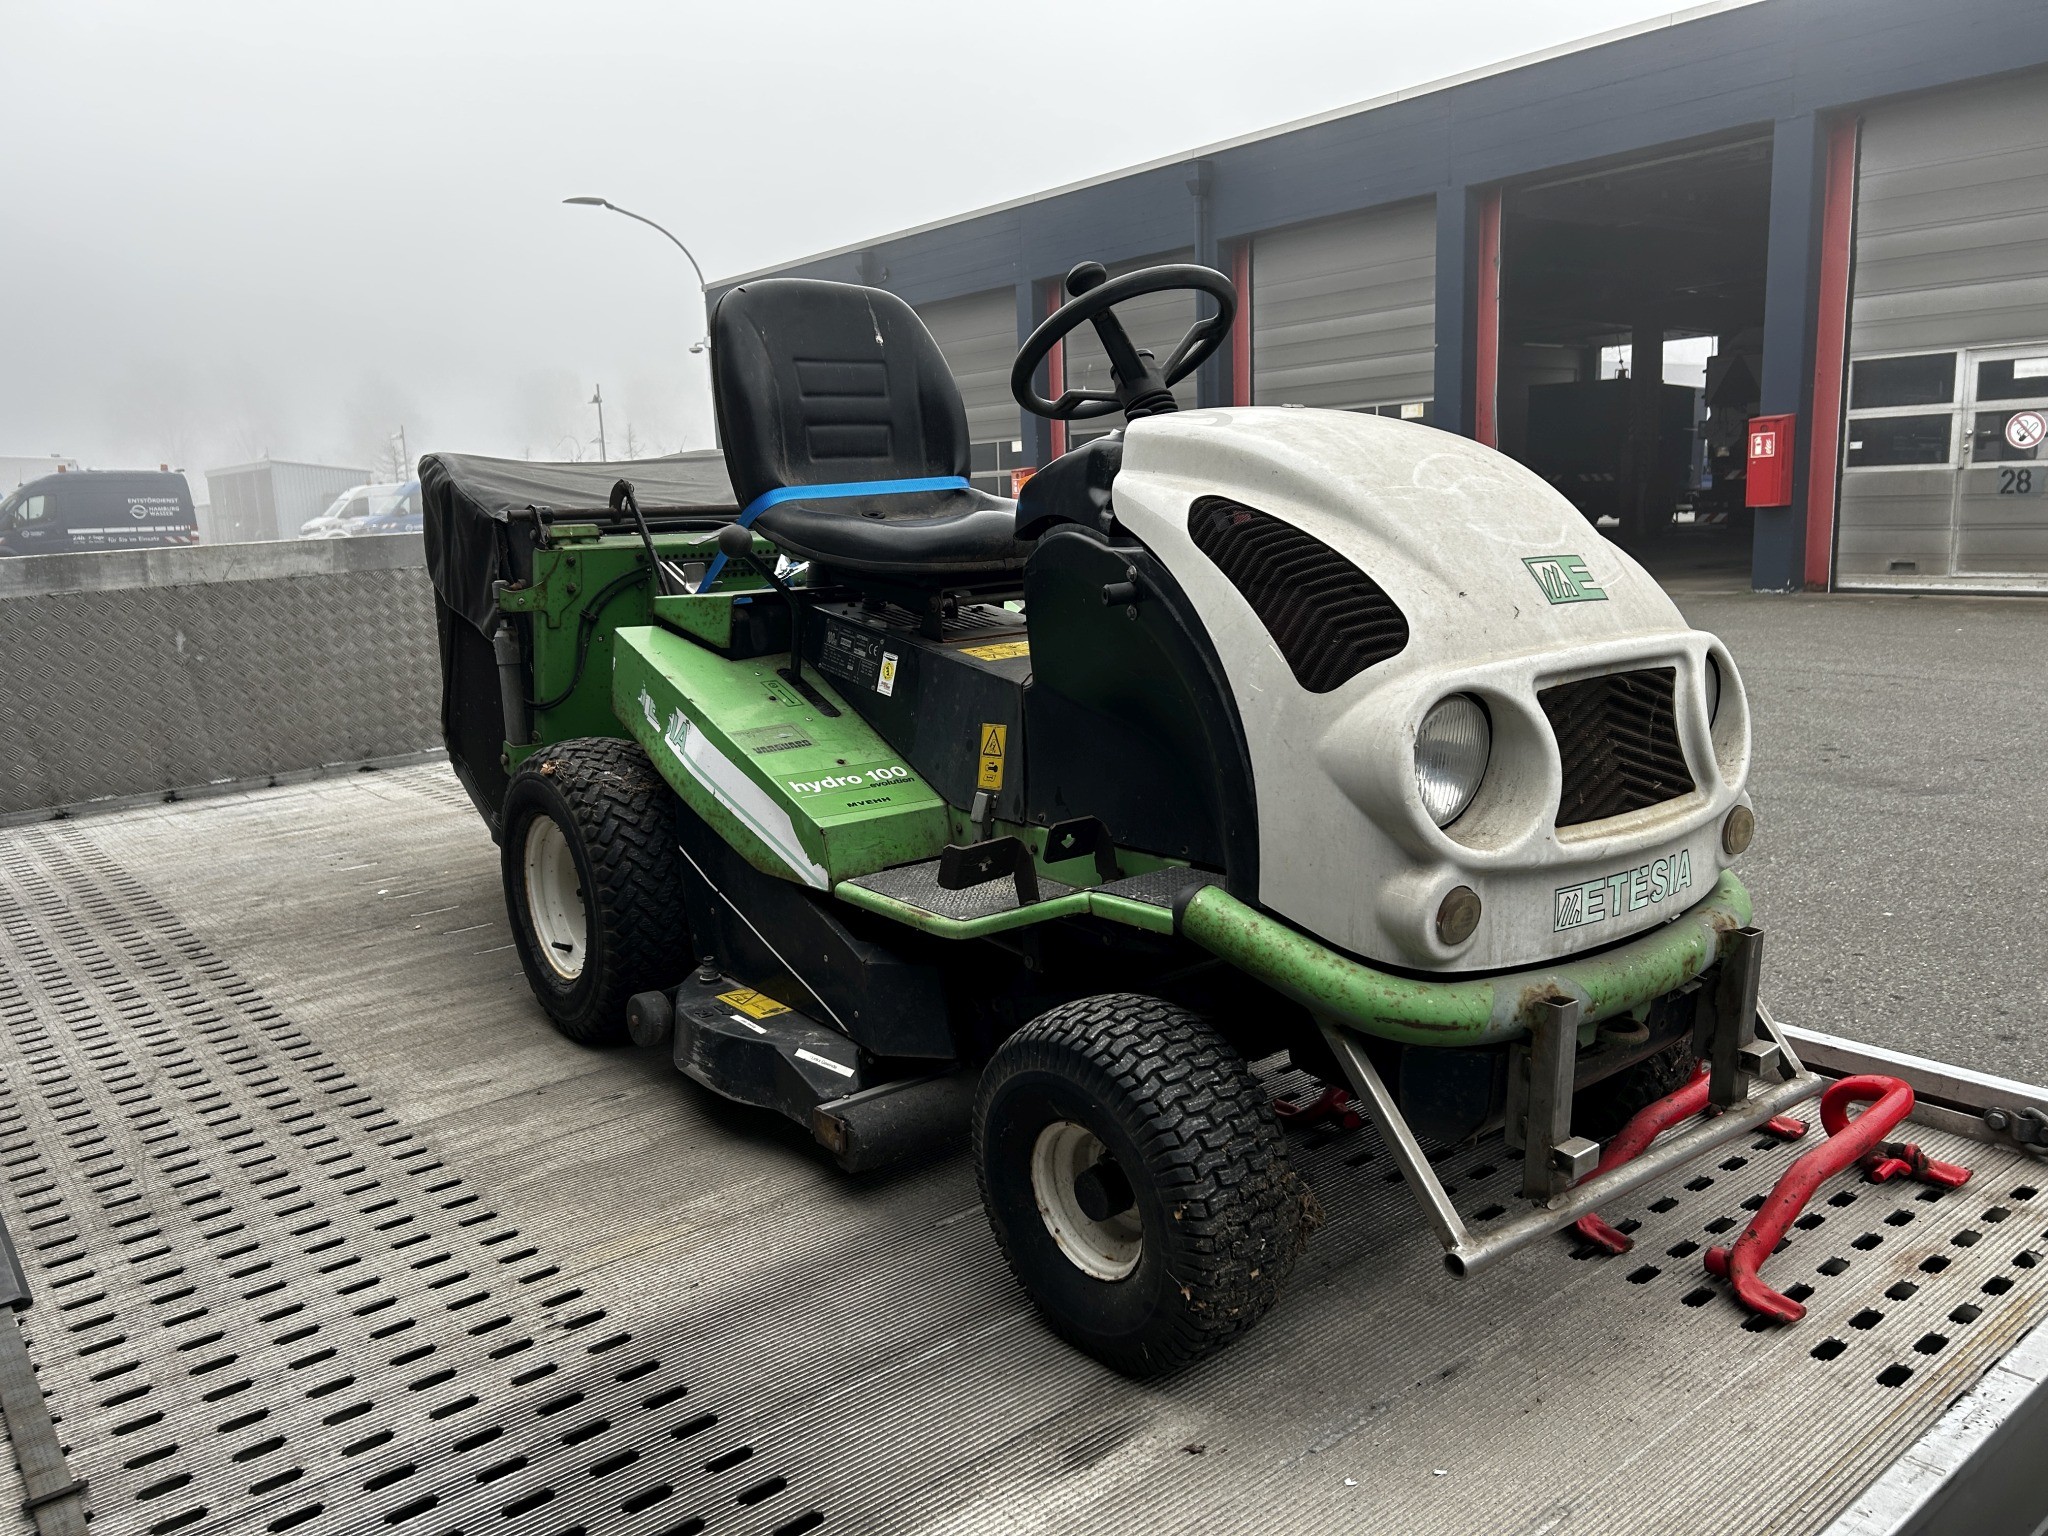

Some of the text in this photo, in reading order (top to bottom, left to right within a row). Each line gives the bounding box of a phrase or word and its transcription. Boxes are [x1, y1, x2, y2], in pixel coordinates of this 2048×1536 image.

[2000, 468, 2032, 494] 28
[752, 739, 812, 754] VANGUARD
[787, 766, 908, 793] hydro 100
[869, 776, 915, 788] evolution
[846, 796, 891, 808] MVEHH
[1579, 849, 1692, 924] ETESIA
